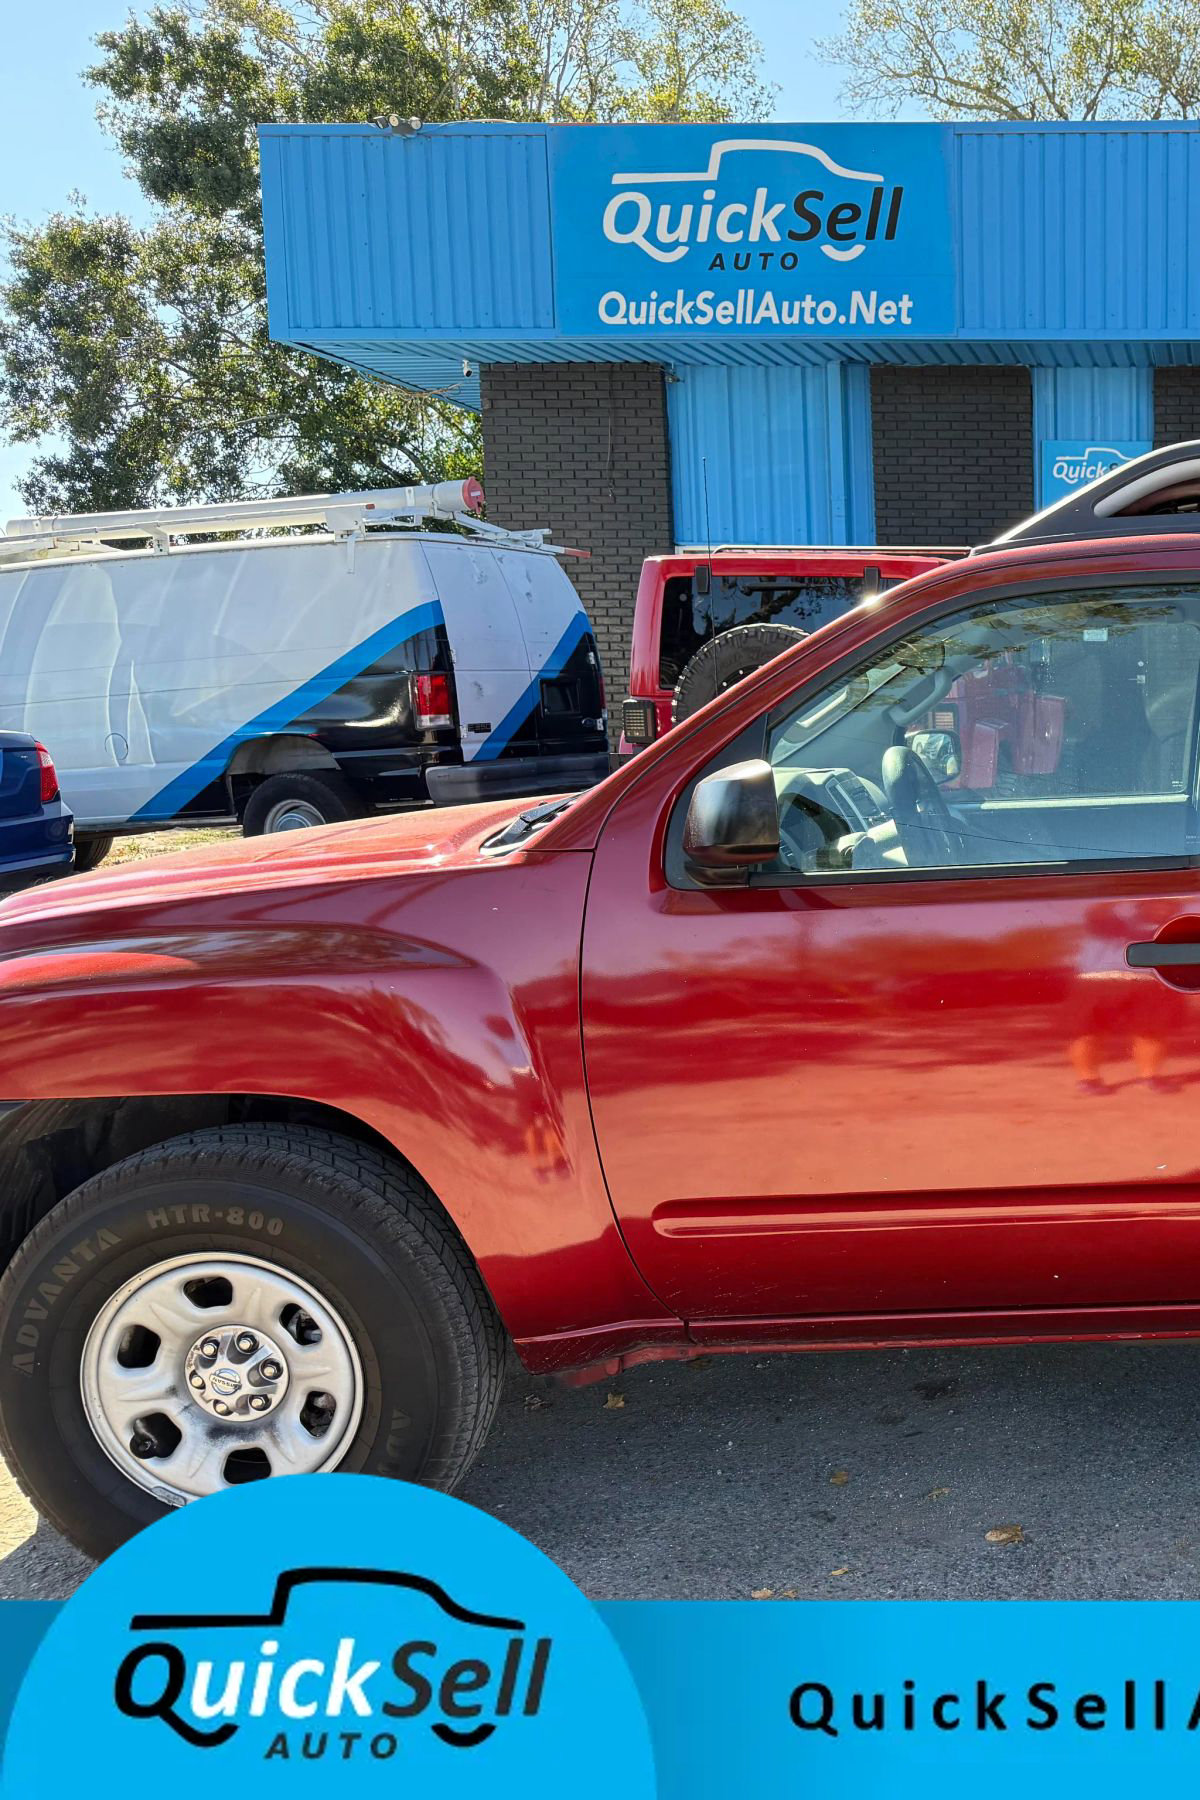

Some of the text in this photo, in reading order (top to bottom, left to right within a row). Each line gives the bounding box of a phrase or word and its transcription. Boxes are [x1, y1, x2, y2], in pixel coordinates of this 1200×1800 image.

[602, 186, 904, 263] QuickSell
[708, 252, 799, 271] AUTO
[598, 289, 913, 325] QuickSellAuto.Net
[12, 1203, 284, 1377] ADVANTA HTR-800
